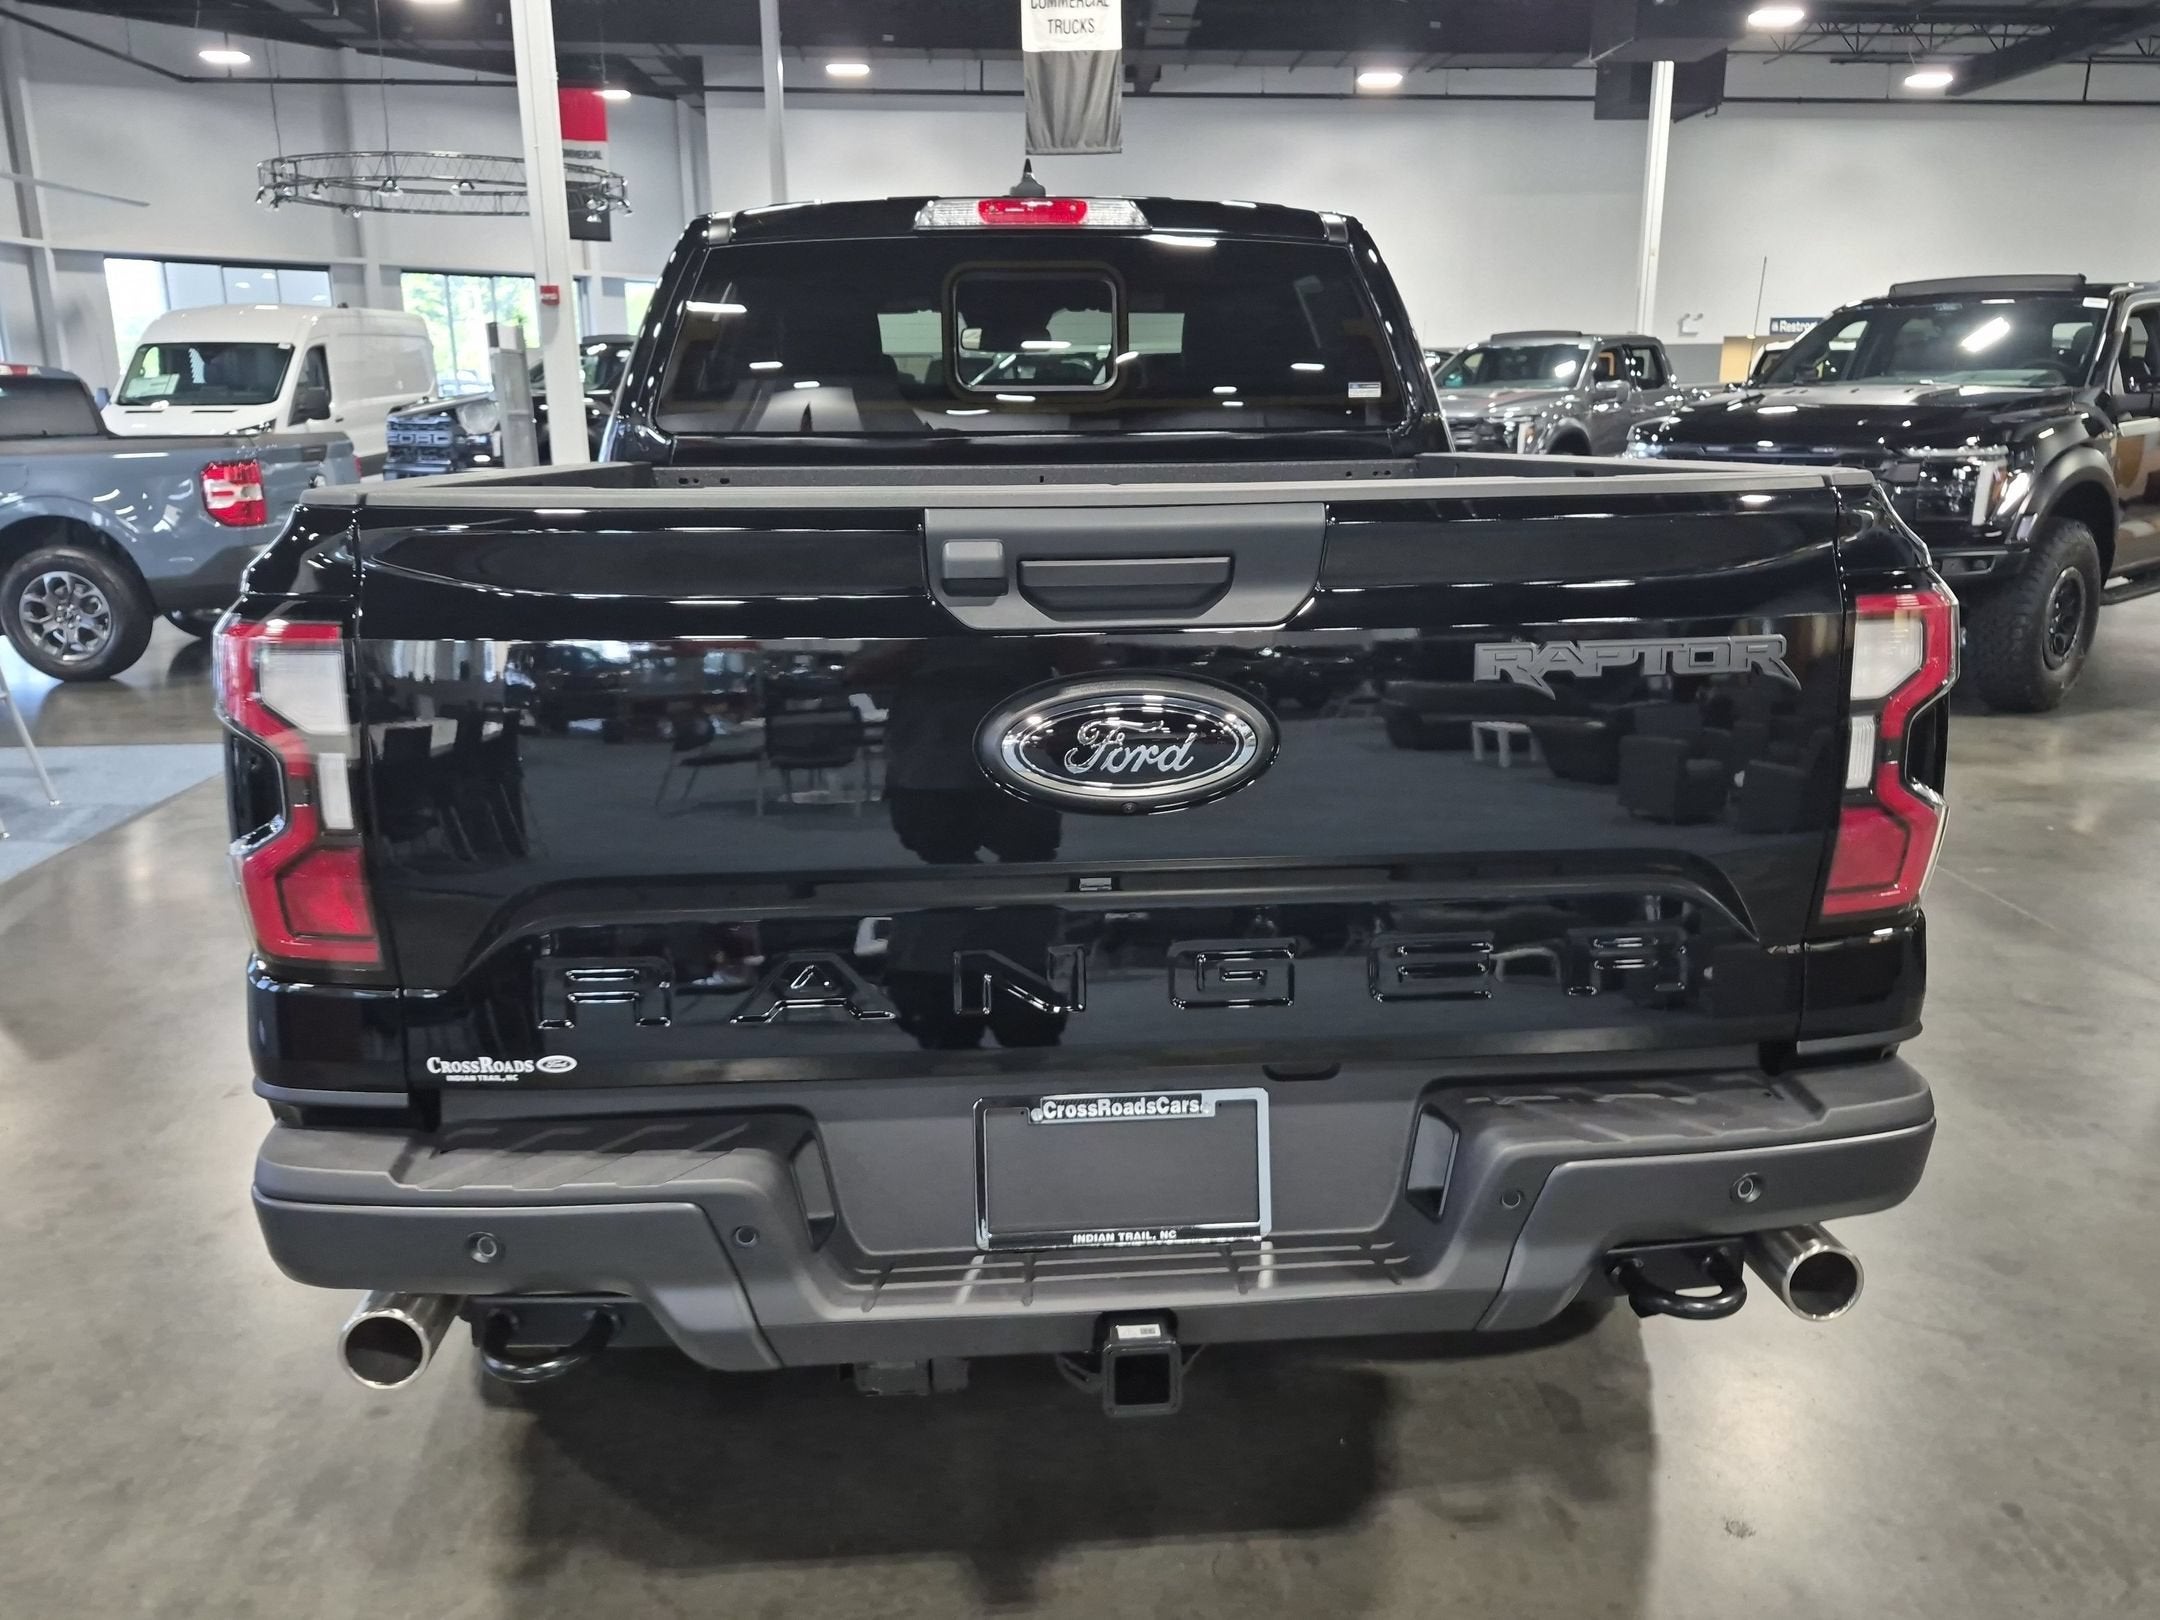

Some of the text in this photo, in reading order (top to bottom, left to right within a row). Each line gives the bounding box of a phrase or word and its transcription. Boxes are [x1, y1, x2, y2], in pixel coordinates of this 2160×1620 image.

[1047, 18, 1095, 34] TRUCKS
[1473, 634, 1802, 700] RAPTOR
[1064, 719, 1198, 774] Ford
[533, 928, 1688, 1028] RANGER
[1043, 1096, 1199, 1120] CrossRoadsCars
[1072, 1229, 1177, 1244] INDIAN TRAIL, NC
